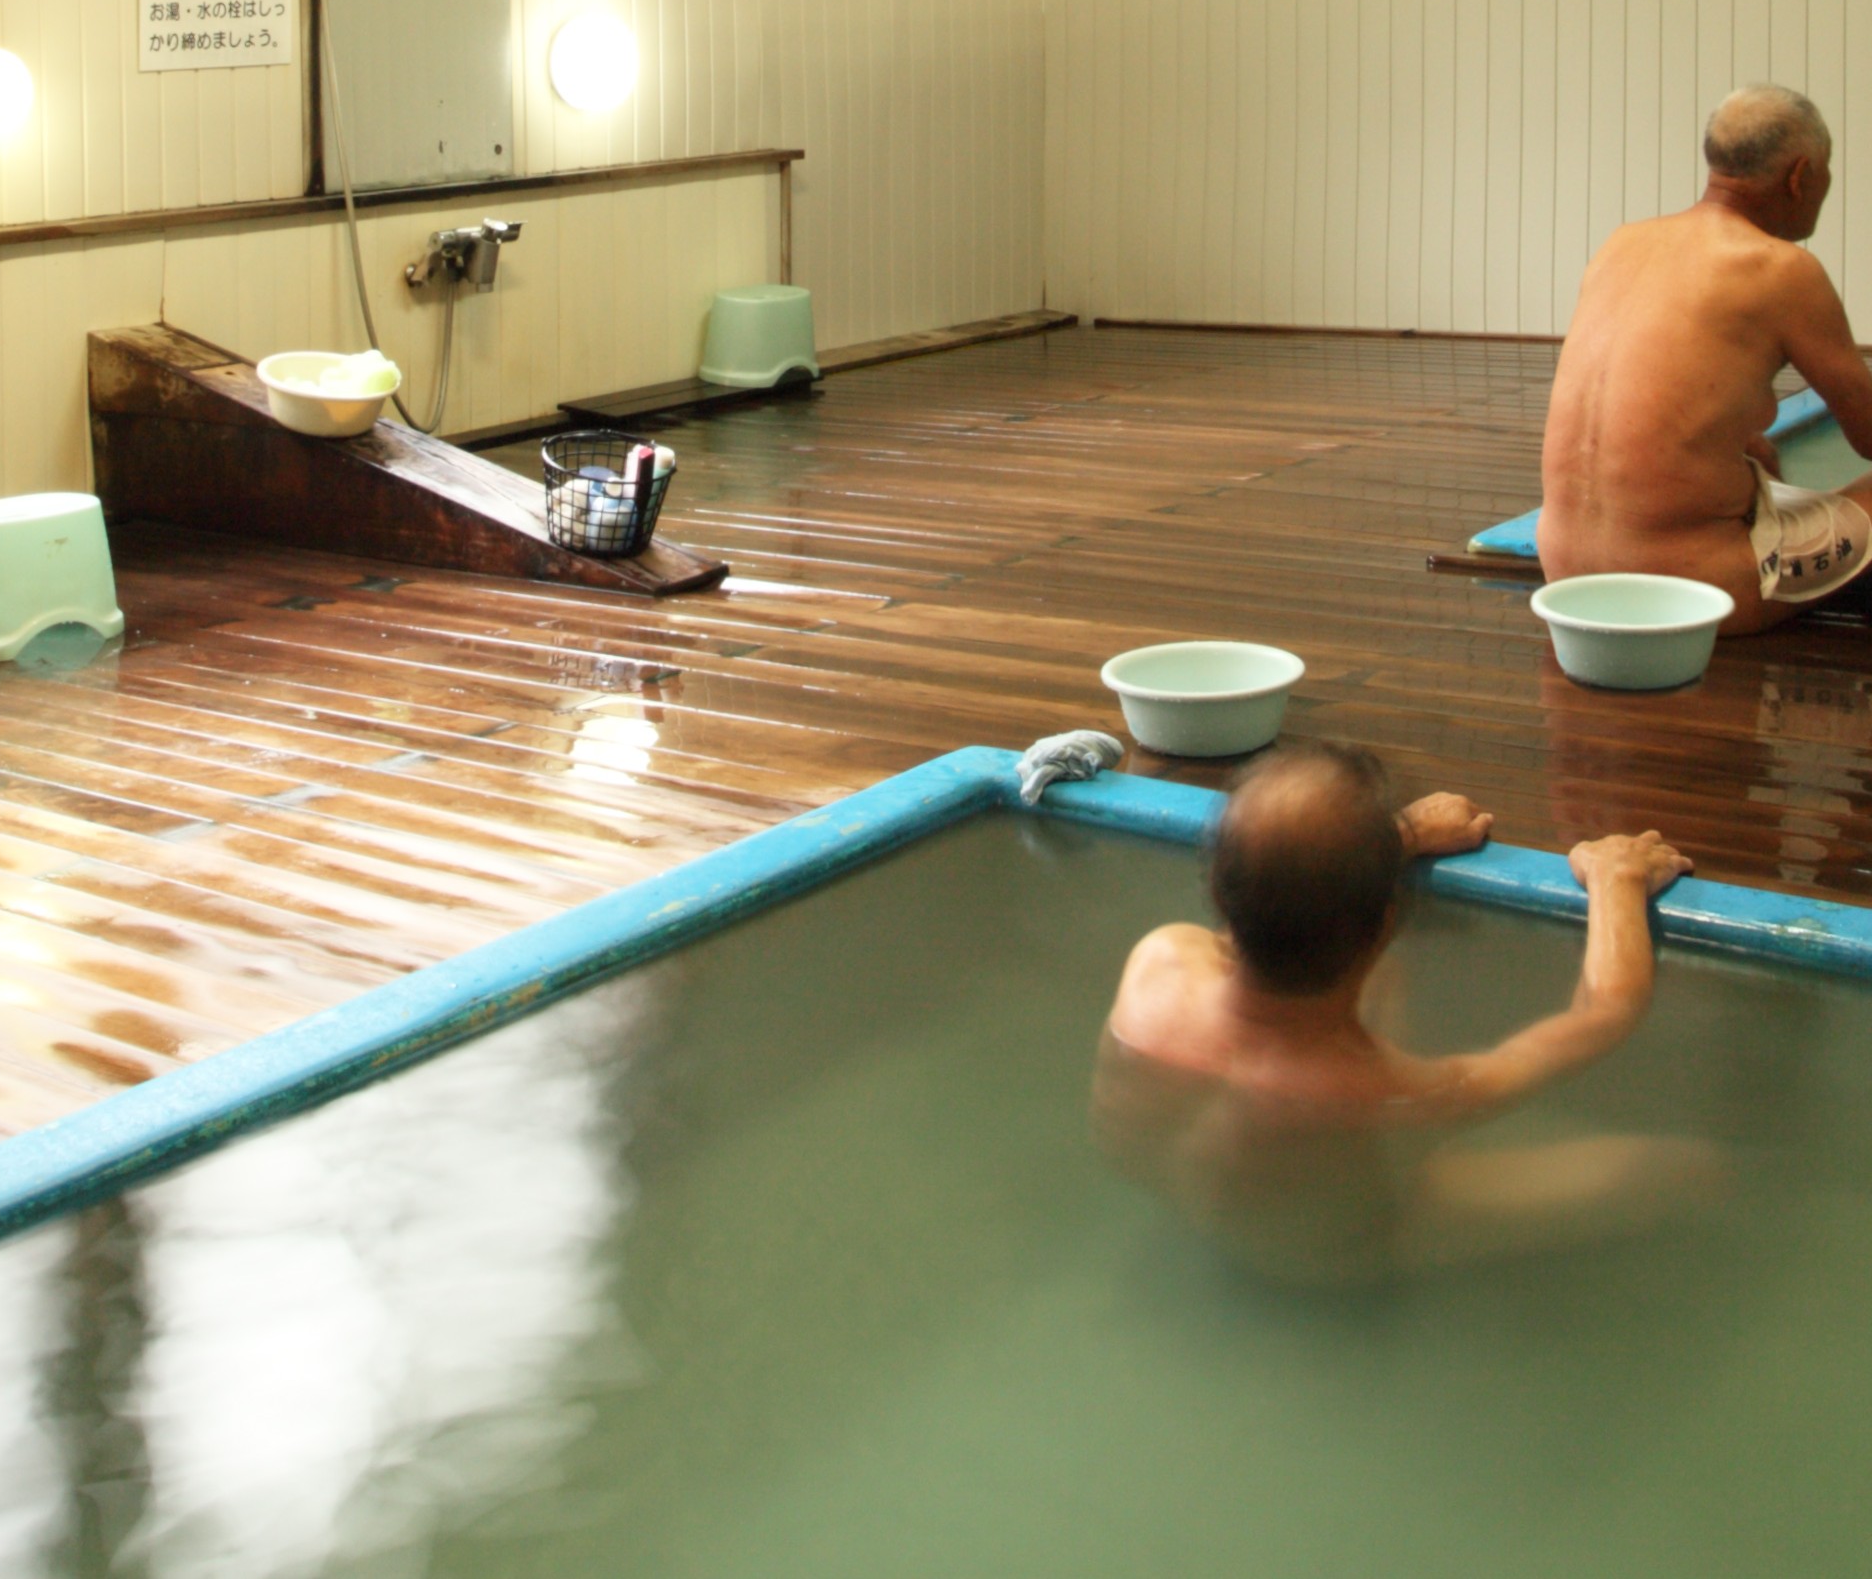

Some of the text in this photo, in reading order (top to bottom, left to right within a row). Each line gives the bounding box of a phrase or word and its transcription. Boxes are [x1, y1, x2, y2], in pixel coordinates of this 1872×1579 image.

[150, 0, 285, 21] お湯・水の栓はしっ
[150, 29, 278, 52] かり締めましょう。
